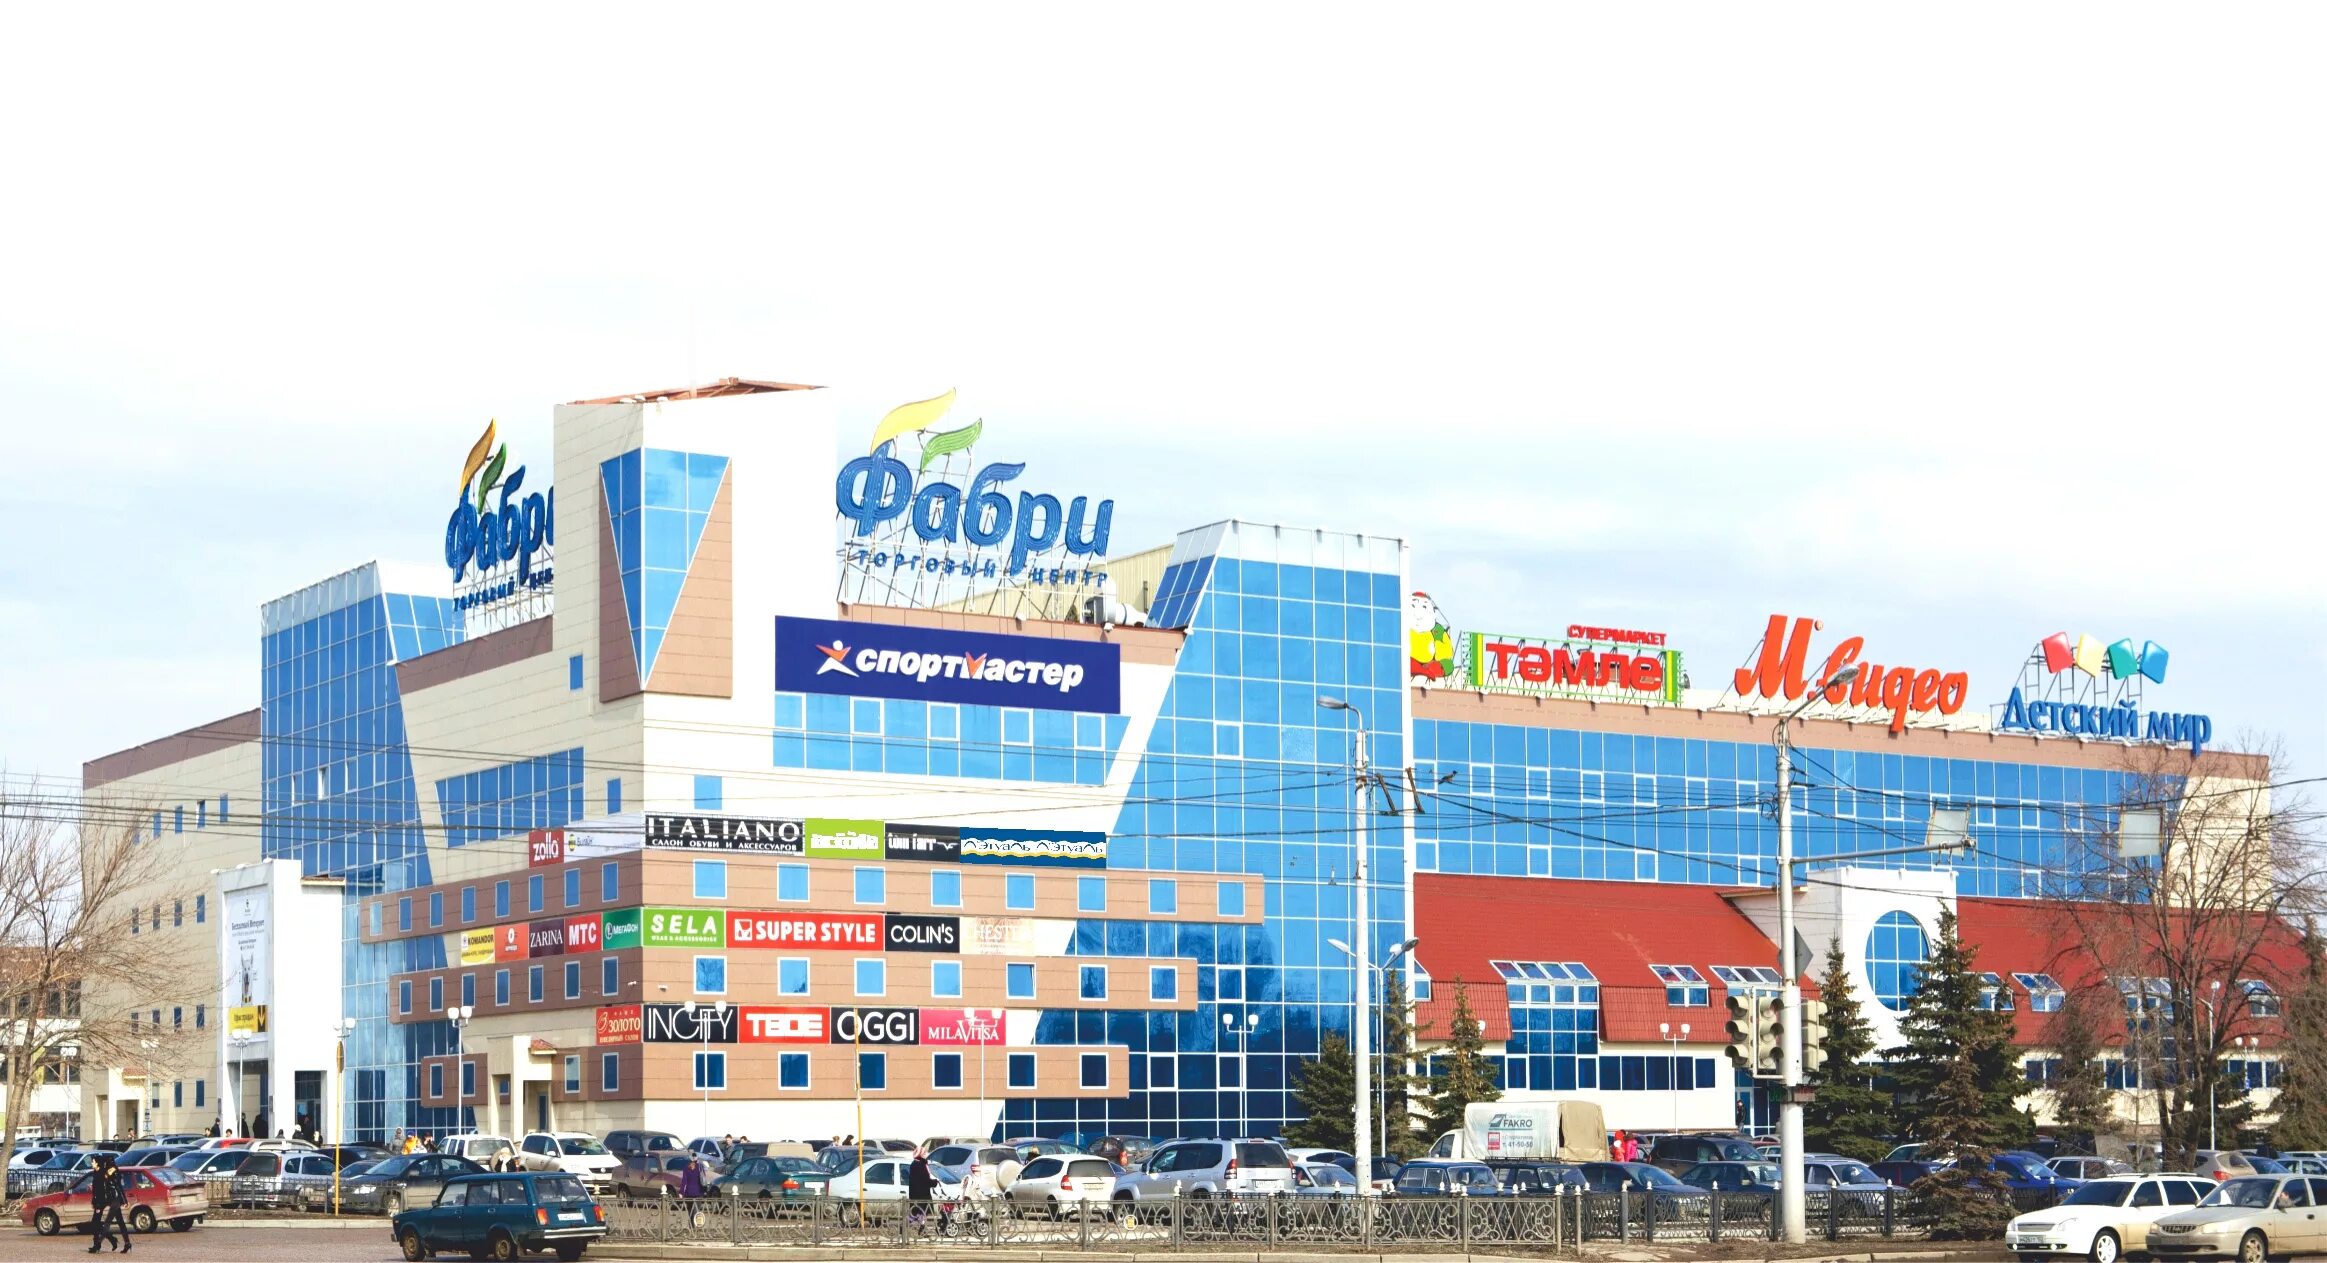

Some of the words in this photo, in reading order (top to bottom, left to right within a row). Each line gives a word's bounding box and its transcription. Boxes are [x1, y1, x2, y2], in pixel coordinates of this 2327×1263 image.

[836, 438, 1114, 575] Фабри
[857, 549, 995, 578] ТОРГОВЫЙ
[1032, 567, 1108, 588] ЦЕНТР
[1567, 624, 1667, 646] СУПЕРМАРКЕТ
[2002, 687, 2138, 738] Детский
[2147, 711, 2212, 757] мир
[647, 817, 800, 842] ITALIANO
[533, 832, 559, 861] zolla
[652, 838, 683, 847] САЛОН
[689, 840, 719, 848] ОБУВИ
[738, 842, 797, 851] АКСЕССУАРОВ
[651, 914, 717, 935] SELA
[755, 920, 816, 941] SUPER
[820, 922, 876, 943] STYLE
[890, 923, 954, 944] COLIN'S
[530, 929, 563, 948] ZARINA
[608, 1017, 641, 1033] ЗОЛОТО
[648, 1007, 733, 1040] INCITY
[837, 1011, 915, 1041] OGGI
[1503, 1119, 1533, 1128] FAKRO
